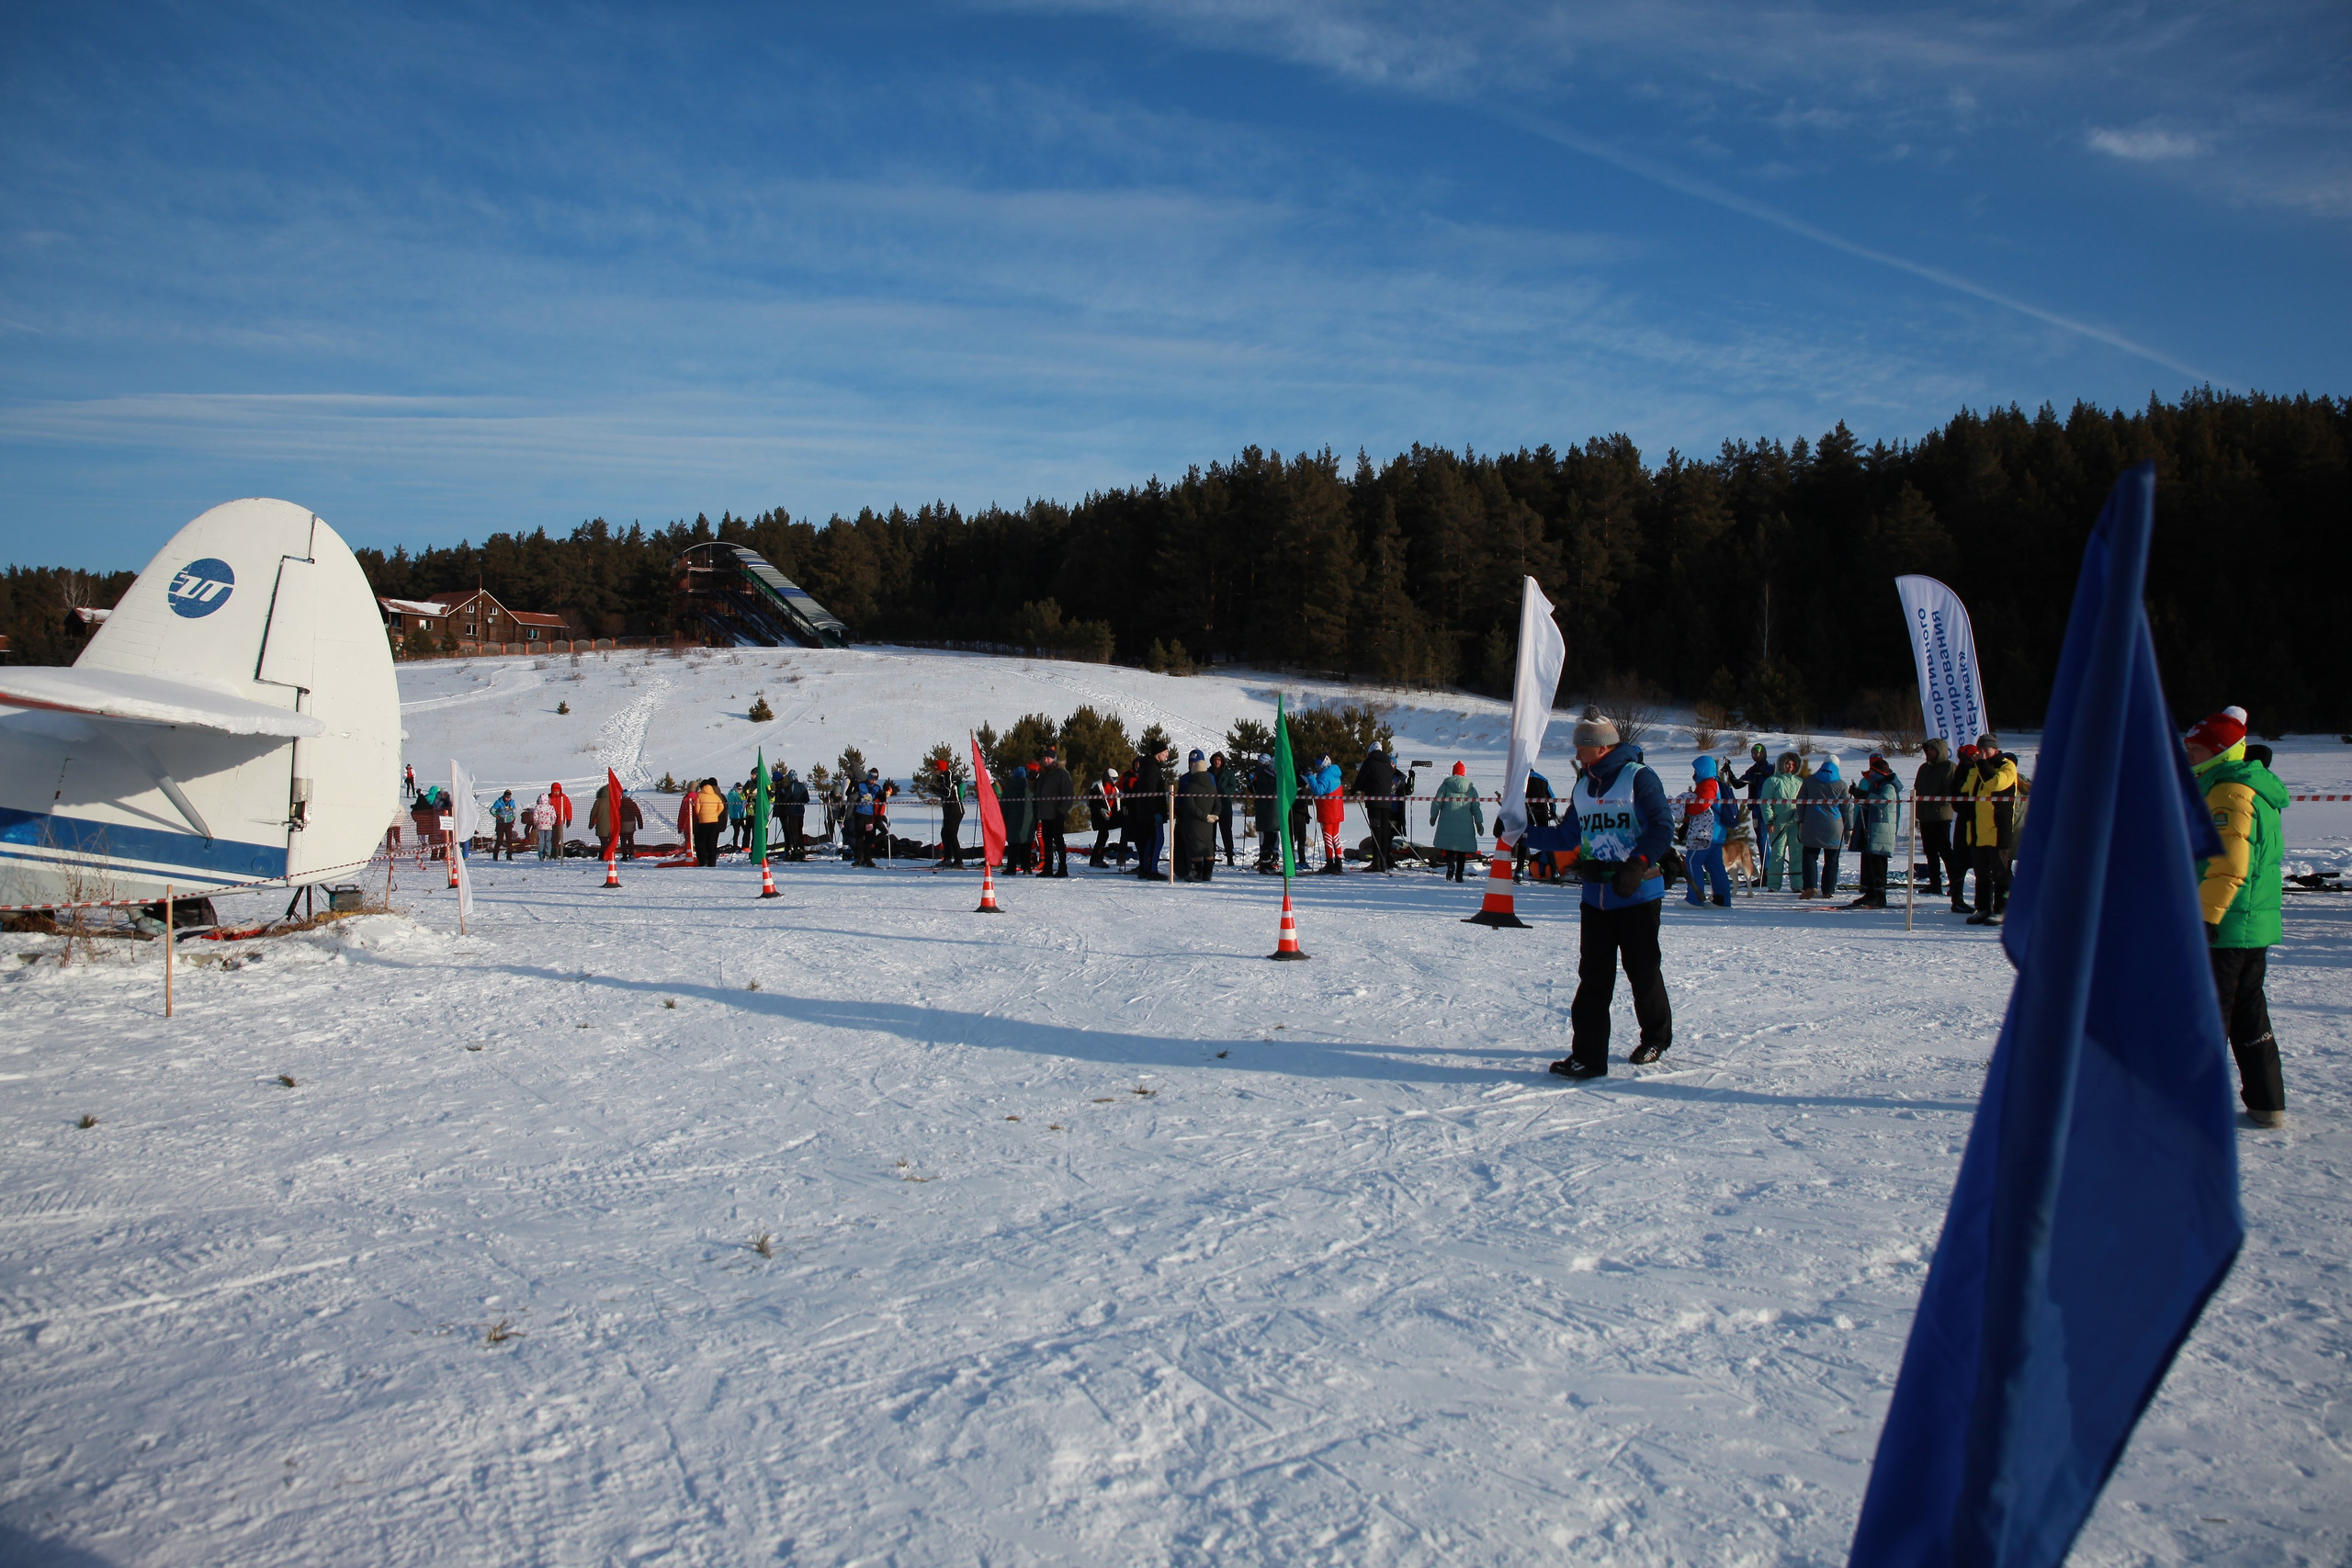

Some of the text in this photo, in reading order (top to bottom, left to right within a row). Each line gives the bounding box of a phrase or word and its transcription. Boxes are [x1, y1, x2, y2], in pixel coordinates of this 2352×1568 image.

[1917, 607, 1949, 740] спортивного
[1931, 611, 1965, 747] ентирования
[1959, 650, 1978, 737] «Ермак»
